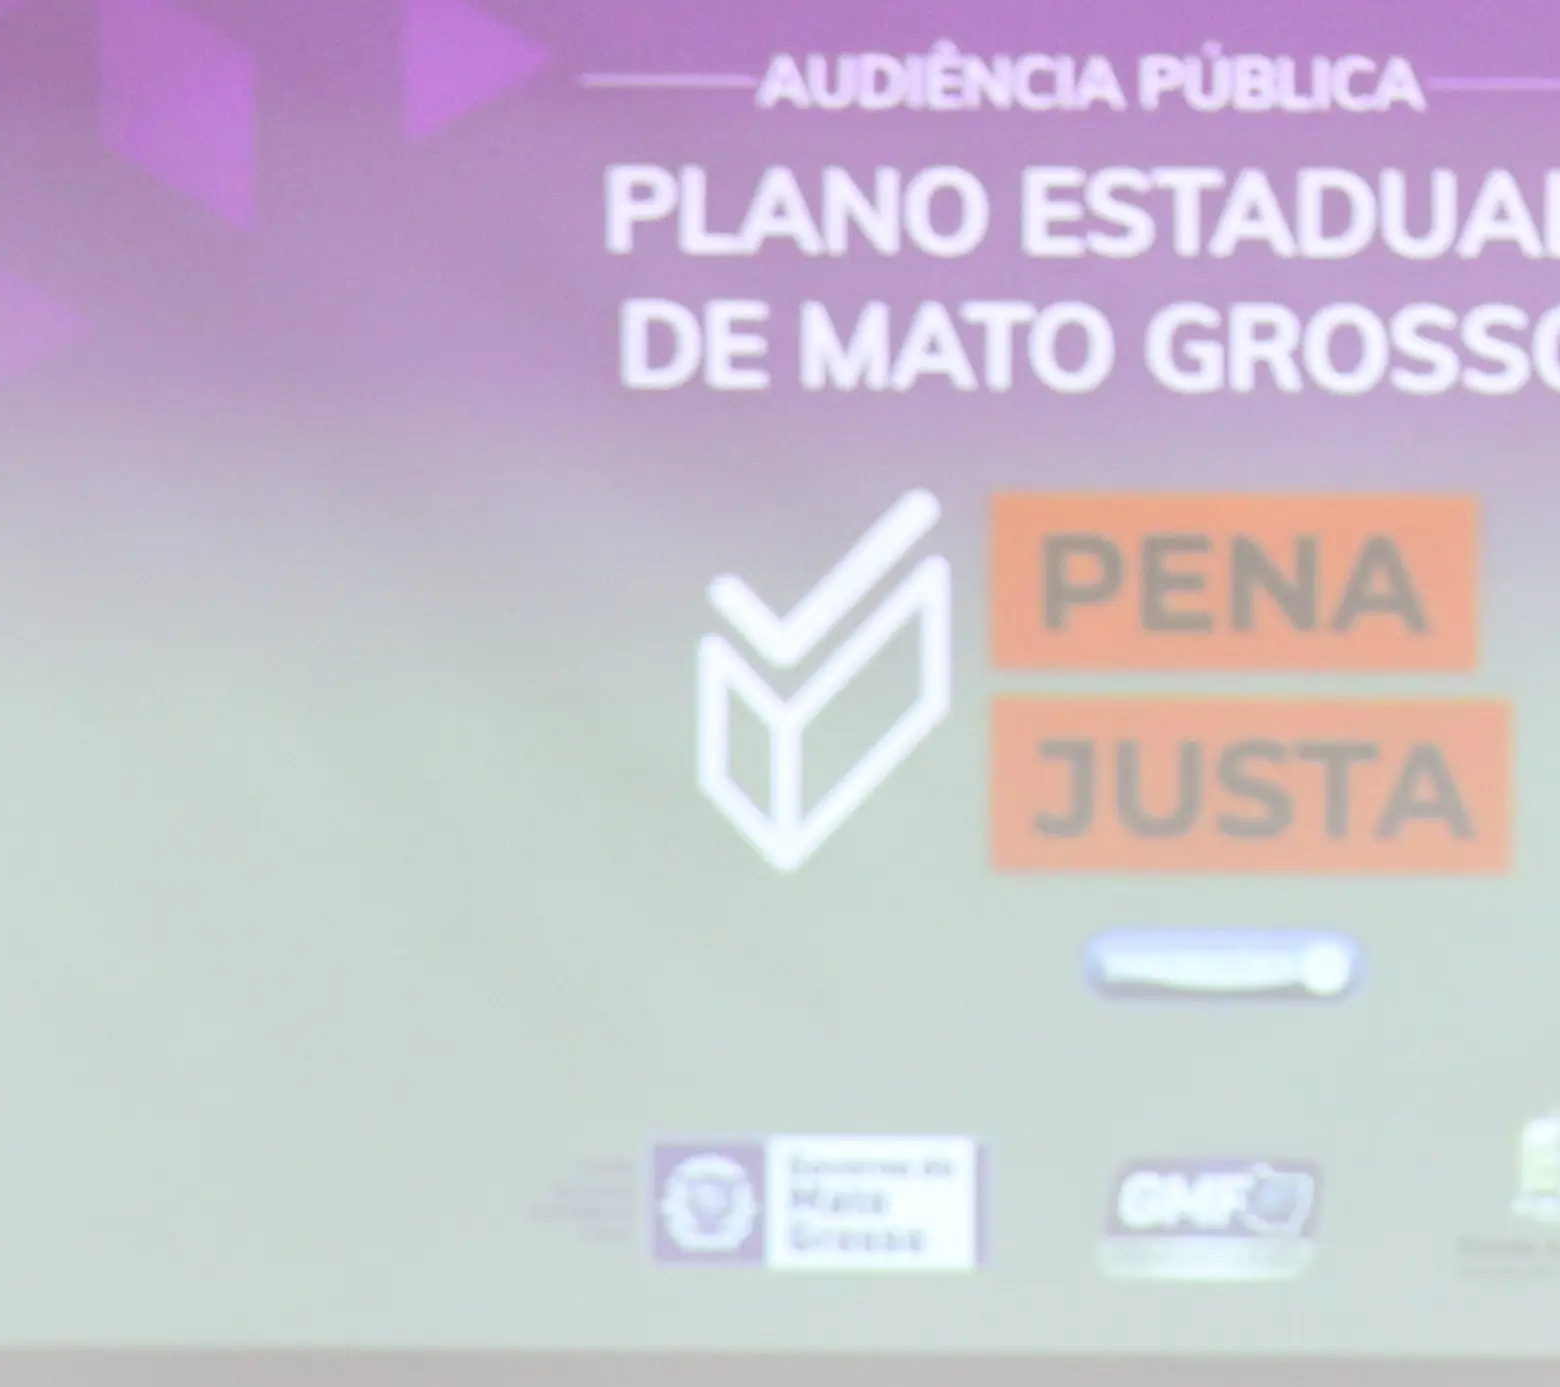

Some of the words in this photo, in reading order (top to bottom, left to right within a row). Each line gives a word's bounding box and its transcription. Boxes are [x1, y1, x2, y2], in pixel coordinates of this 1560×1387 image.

[756, 40, 1128, 111] AUDIÊNCIA
[1139, 42, 1427, 112] PÚBLICA
[604, 164, 990, 257] PLANO
[621, 298, 770, 390] DE
[801, 301, 1115, 393] MATO
[1041, 533, 1428, 634] PENA
[1033, 738, 1475, 841] JUSTA
